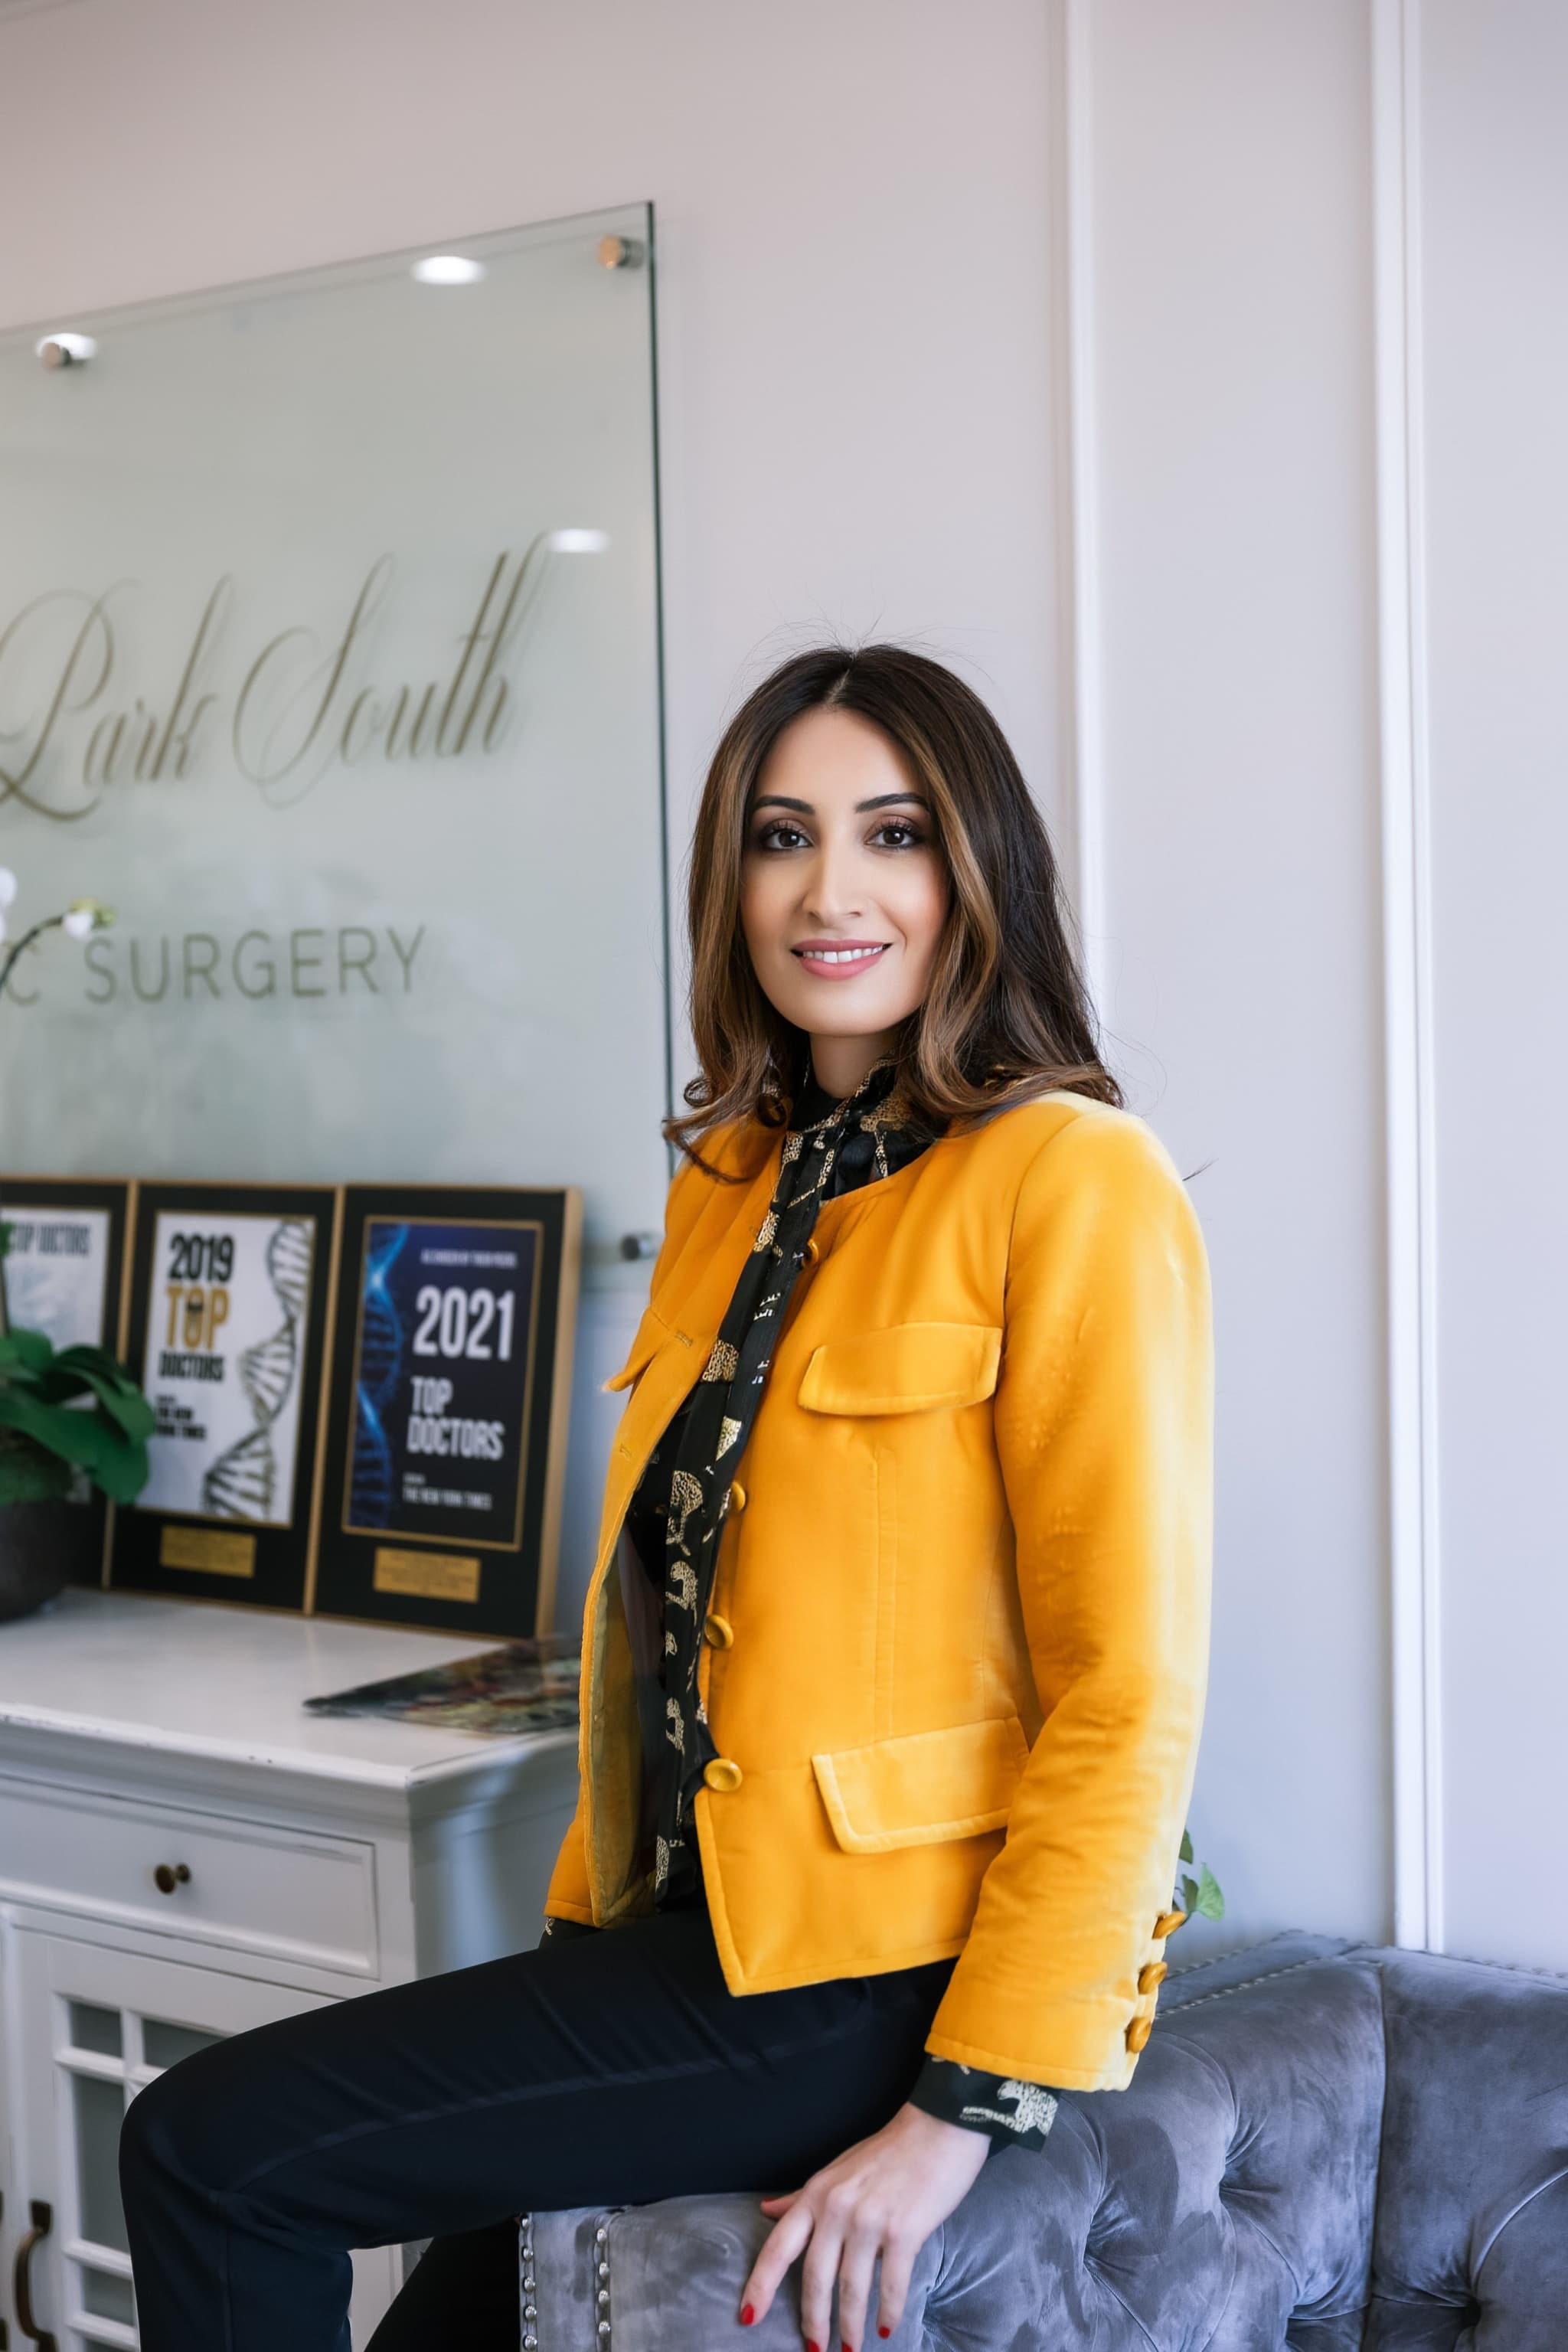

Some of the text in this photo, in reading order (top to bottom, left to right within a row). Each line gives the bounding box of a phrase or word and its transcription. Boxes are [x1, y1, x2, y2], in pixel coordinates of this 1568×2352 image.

[0, 530, 548, 823] Park South
[83, 925, 426, 1005] SURGERY
[168, 1233, 234, 1282] 2019
[166, 1285, 230, 1350] TOP
[412, 1285, 516, 1361] 2021
[158, 1352, 224, 1383] DOCTORS
[410, 1375, 454, 1416] TOP
[406, 1416, 505, 1461] DOCTORS
